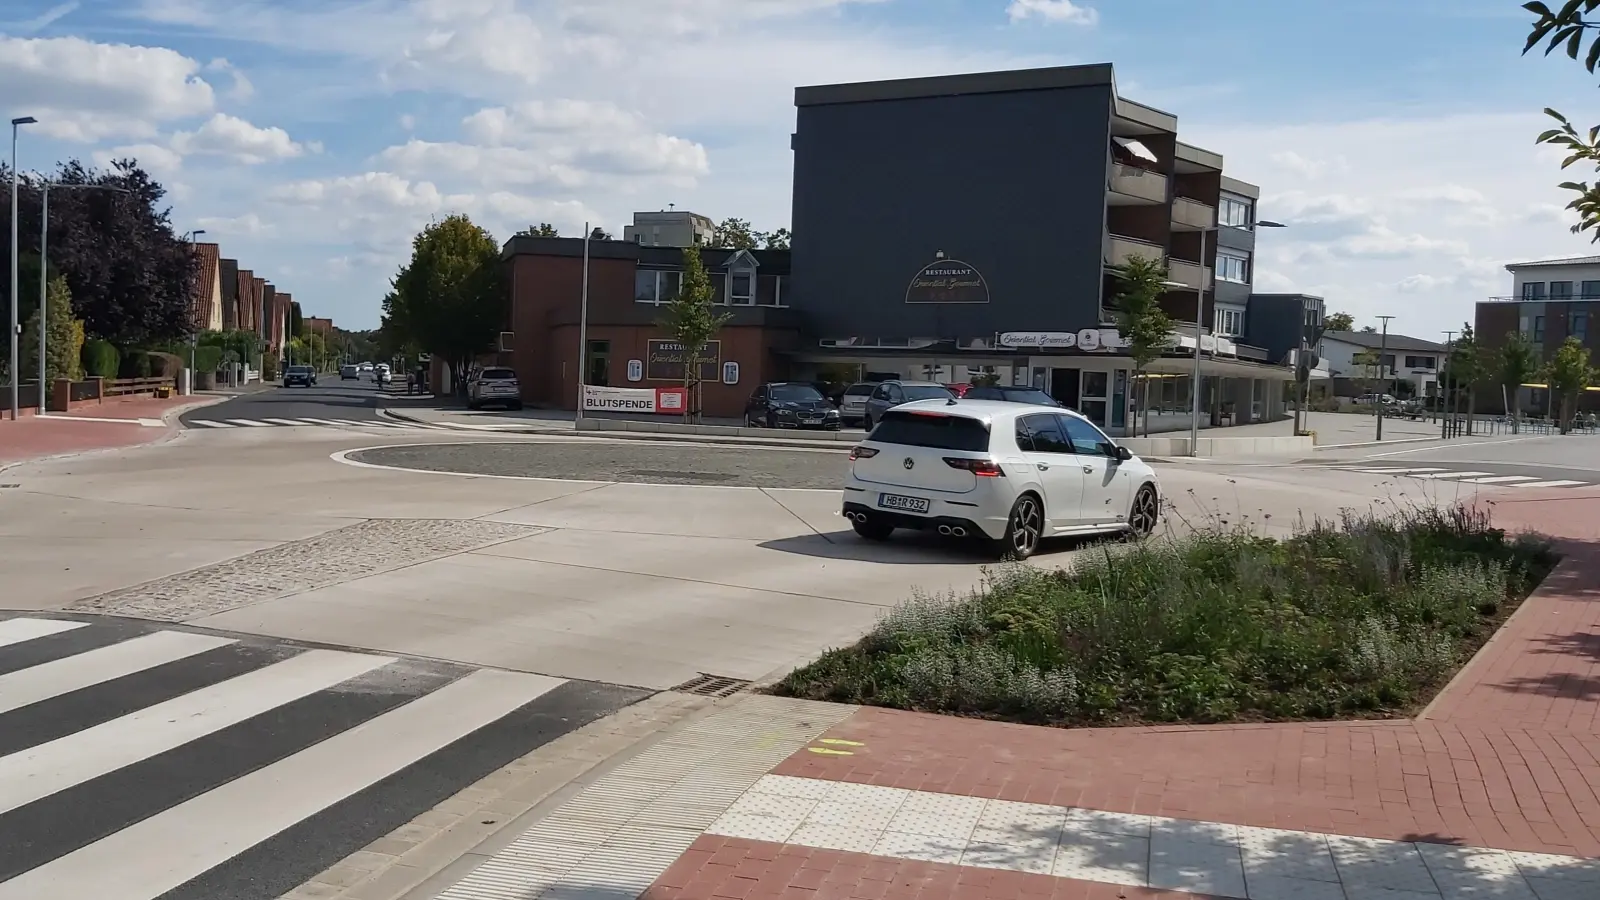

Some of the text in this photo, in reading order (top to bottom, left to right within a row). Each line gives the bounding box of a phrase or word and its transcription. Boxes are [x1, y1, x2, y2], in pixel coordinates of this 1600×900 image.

[1038, 334, 1072, 346] Gourmet
[586, 398, 653, 409] BLUTSPENDE
[909, 499, 926, 509] 932
